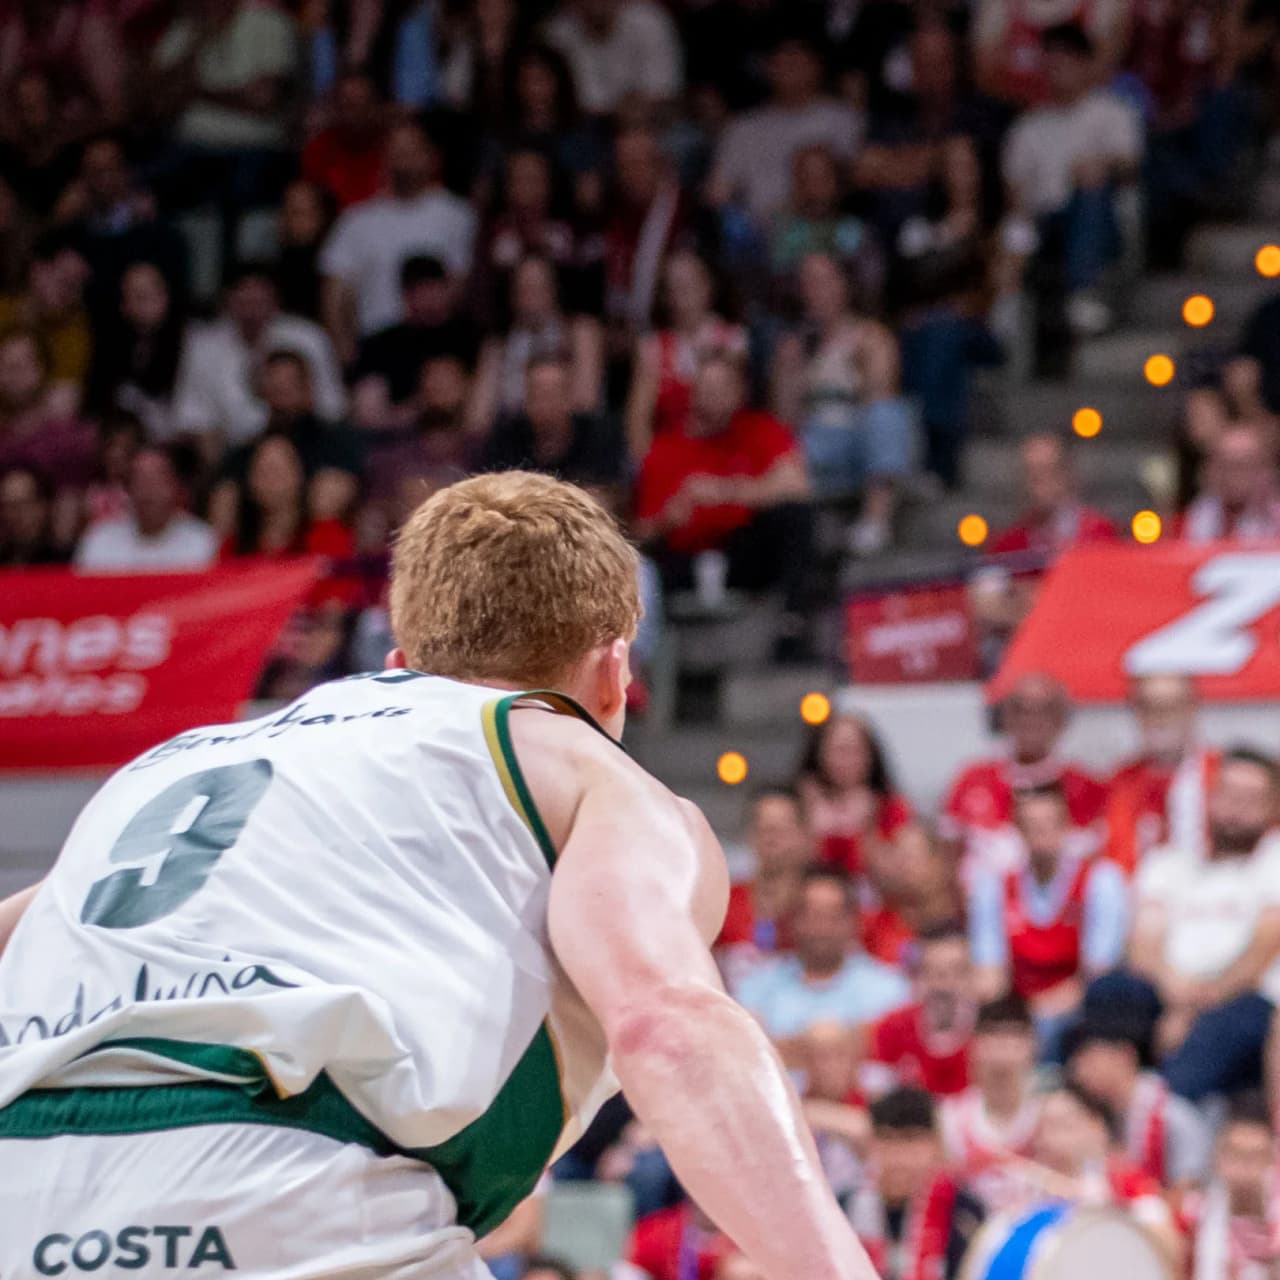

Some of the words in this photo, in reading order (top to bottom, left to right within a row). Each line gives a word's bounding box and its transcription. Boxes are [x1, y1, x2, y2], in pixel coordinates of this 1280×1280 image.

[0, 613, 172, 673] nes
[80, 759, 274, 930] 9
[33, 1225, 238, 1277] COSTA
